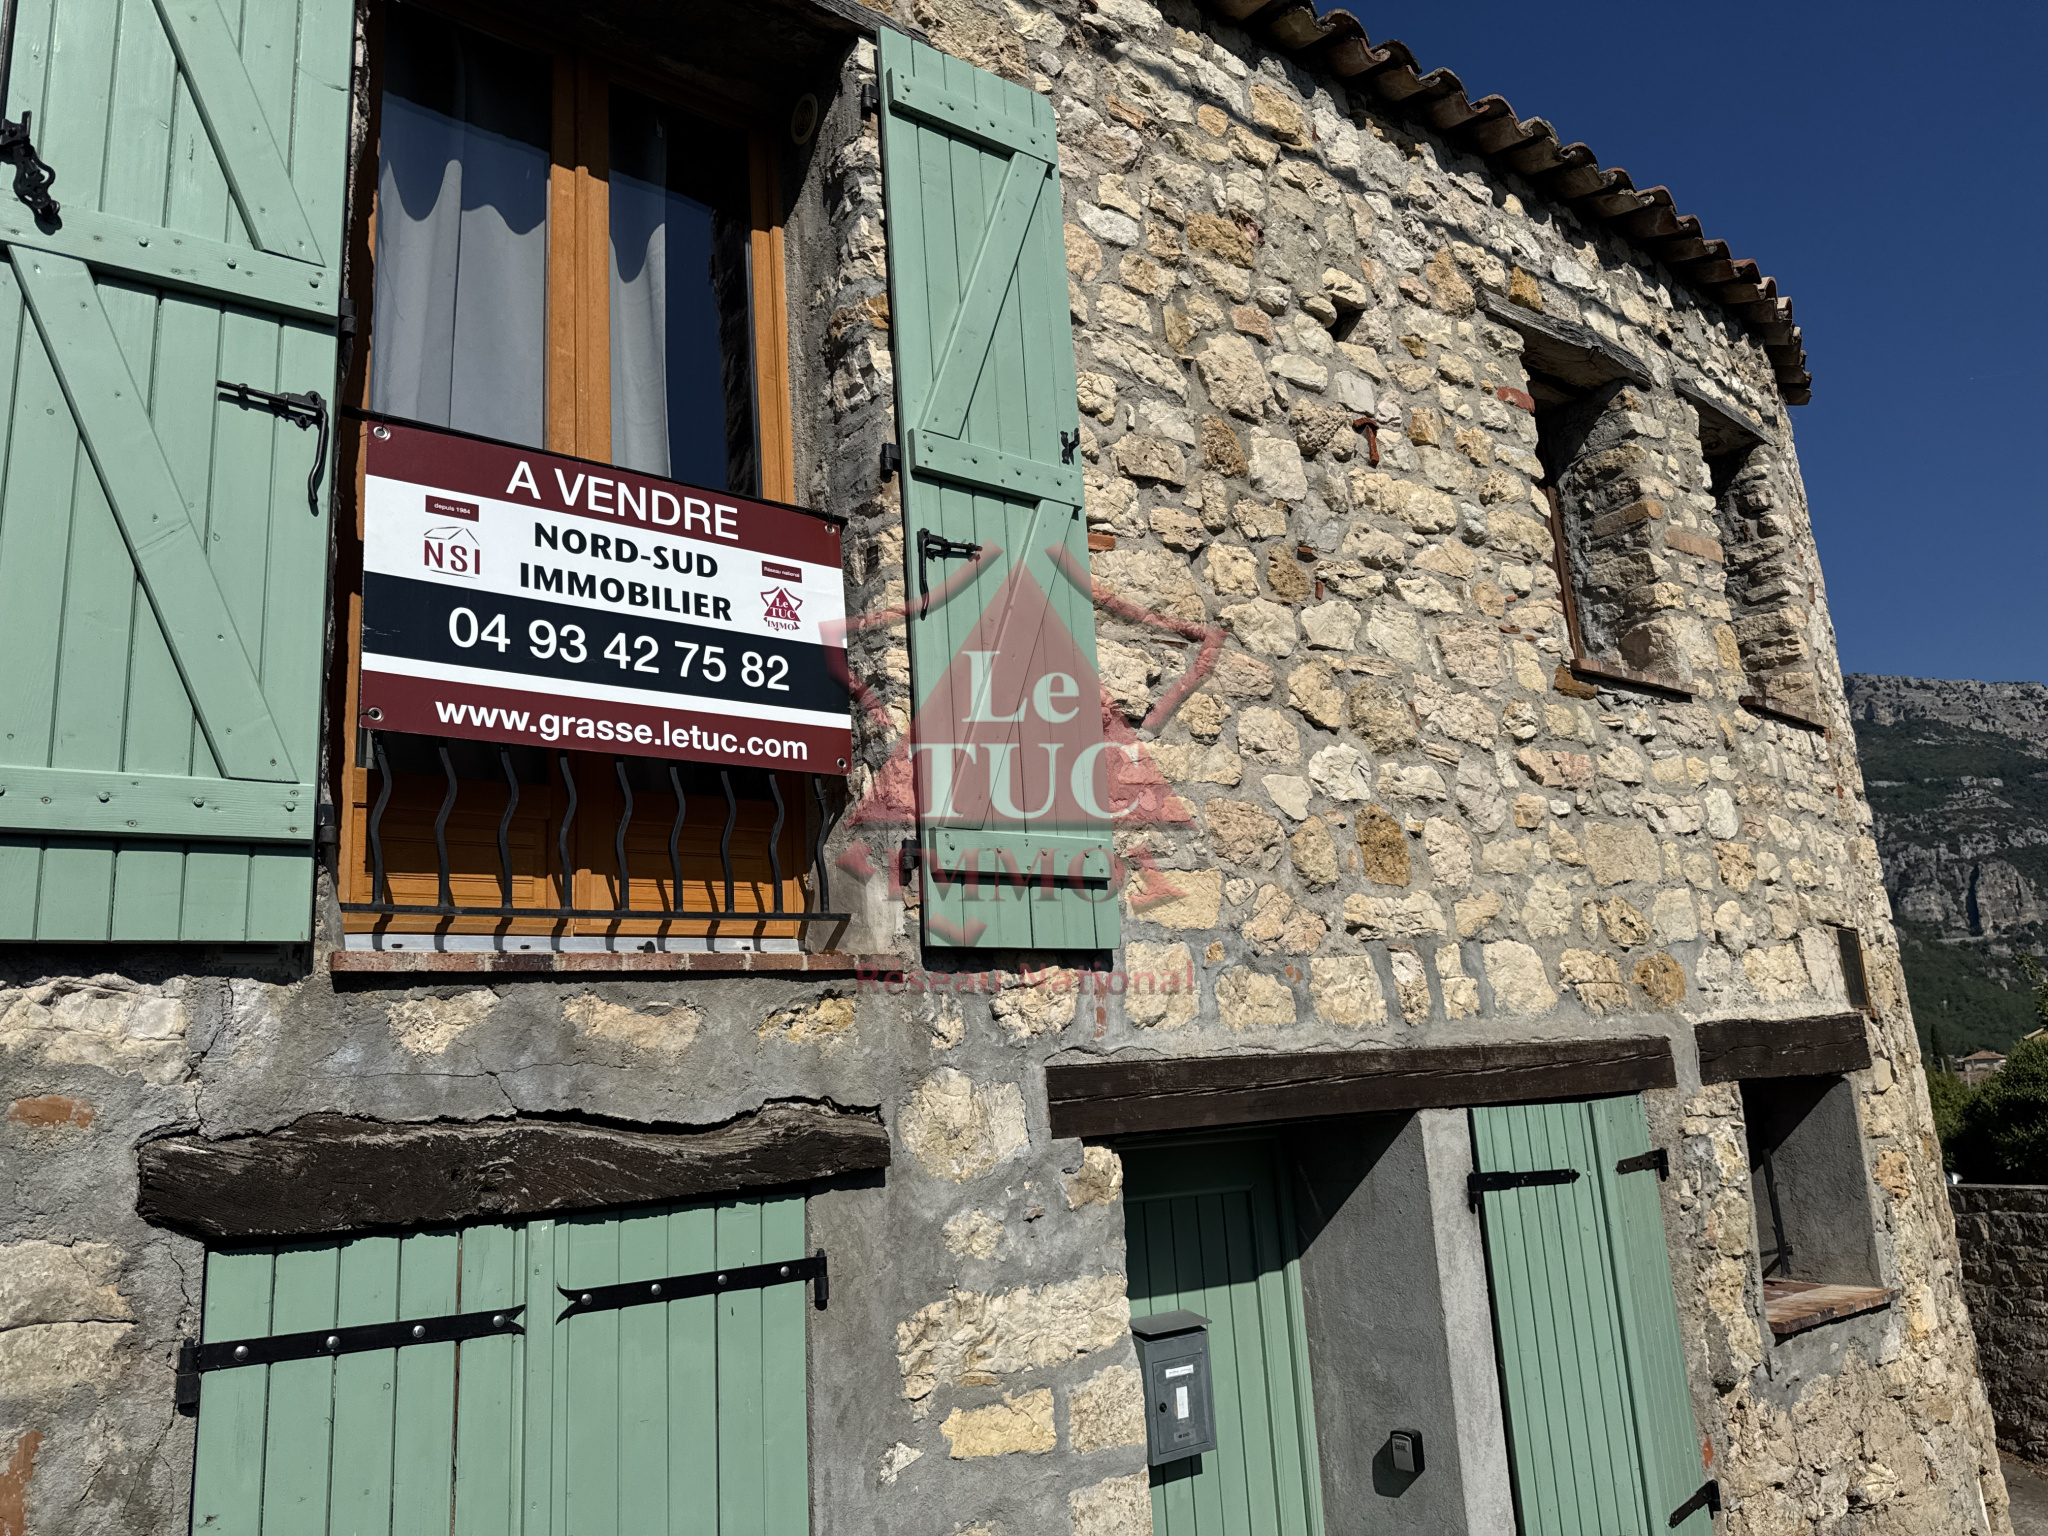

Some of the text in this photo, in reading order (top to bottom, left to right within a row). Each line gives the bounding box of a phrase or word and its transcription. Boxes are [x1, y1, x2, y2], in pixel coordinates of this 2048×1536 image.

[434, 503, 454, 512] depuis
[505, 460, 739, 540] A VENDRE
[424, 539, 480, 575] NSI
[534, 522, 718, 578] NORD-SUD
[520, 562, 732, 621] IMMOBILIER
[770, 606, 795, 619] TUC
[775, 598, 788, 608] Le
[767, 620, 794, 630] IMMO
[449, 607, 790, 691] 04 93 42 75 82
[435, 701, 808, 760] www.grasse.letuc.com
